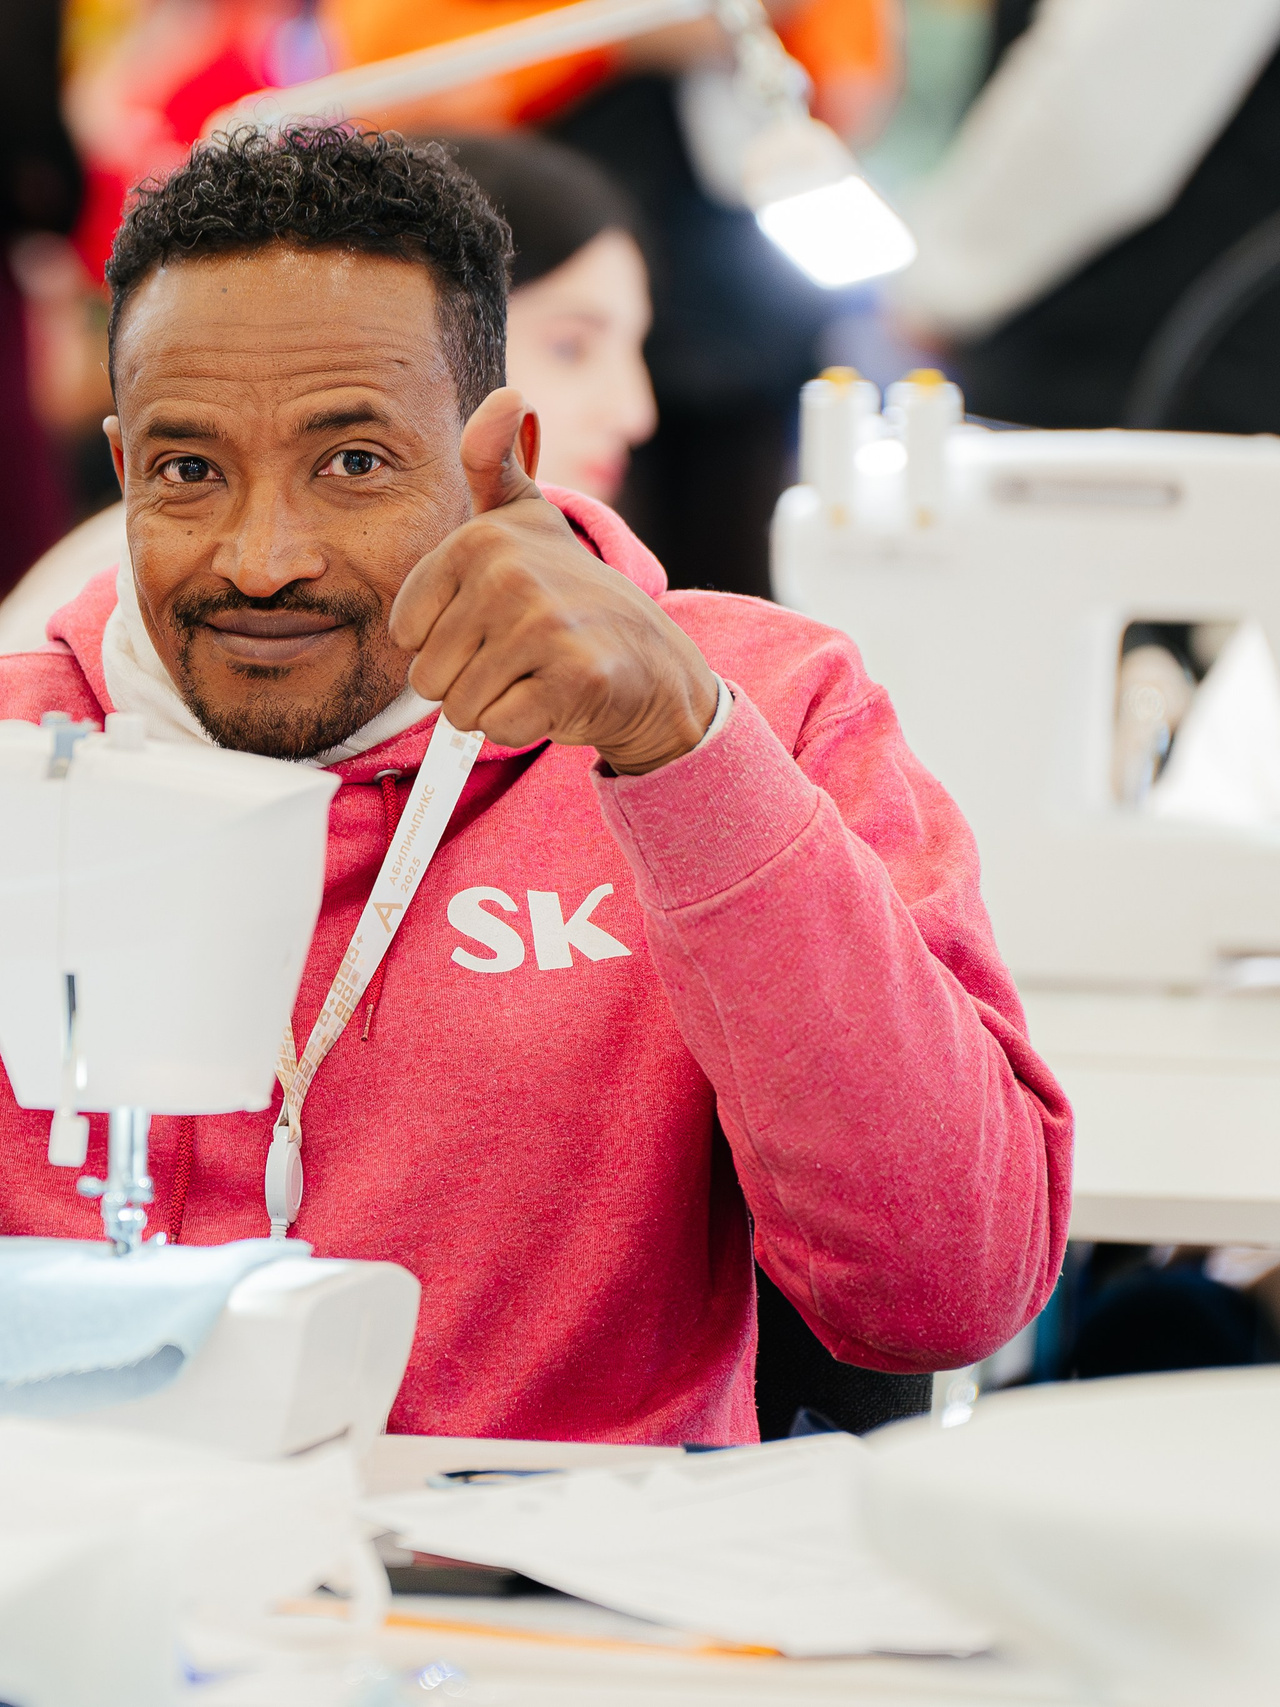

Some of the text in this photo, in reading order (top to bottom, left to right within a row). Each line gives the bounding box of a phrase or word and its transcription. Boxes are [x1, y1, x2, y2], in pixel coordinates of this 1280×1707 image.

[388, 784, 436, 887] АБИЛИМПИКС
[400, 858, 422, 894] 2025
[447, 883, 633, 974] SK
